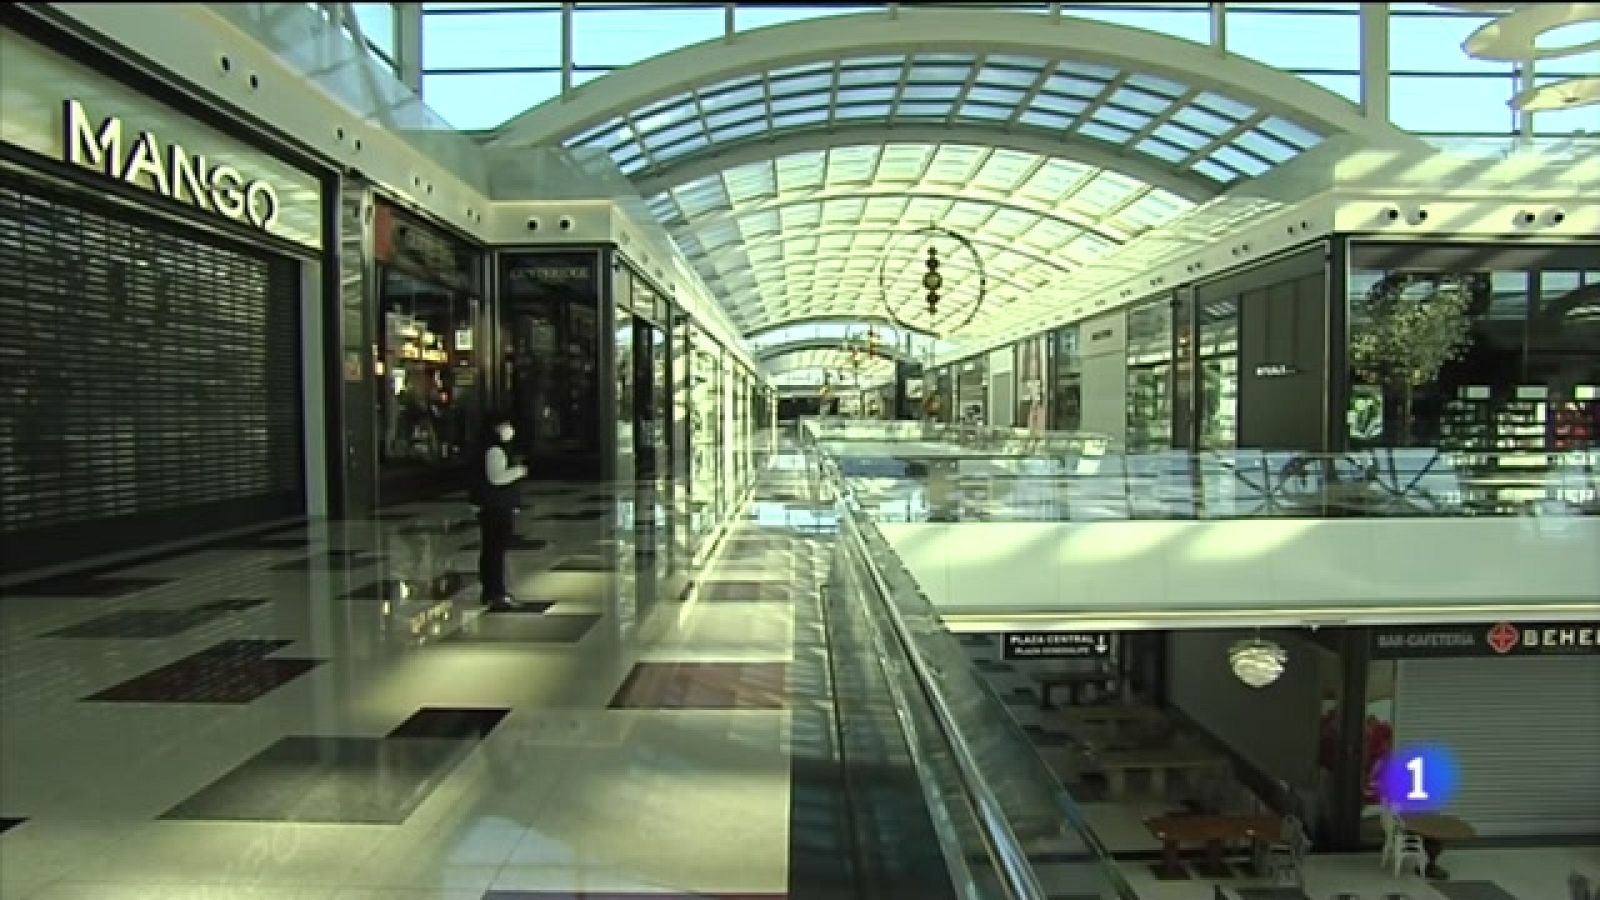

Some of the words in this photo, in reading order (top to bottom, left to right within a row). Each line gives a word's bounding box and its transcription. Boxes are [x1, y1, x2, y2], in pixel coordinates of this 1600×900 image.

[63, 98, 279, 230] MANGO
[1009, 634, 1043, 645] PLAZA
[1047, 634, 1094, 644] CENTRAL
